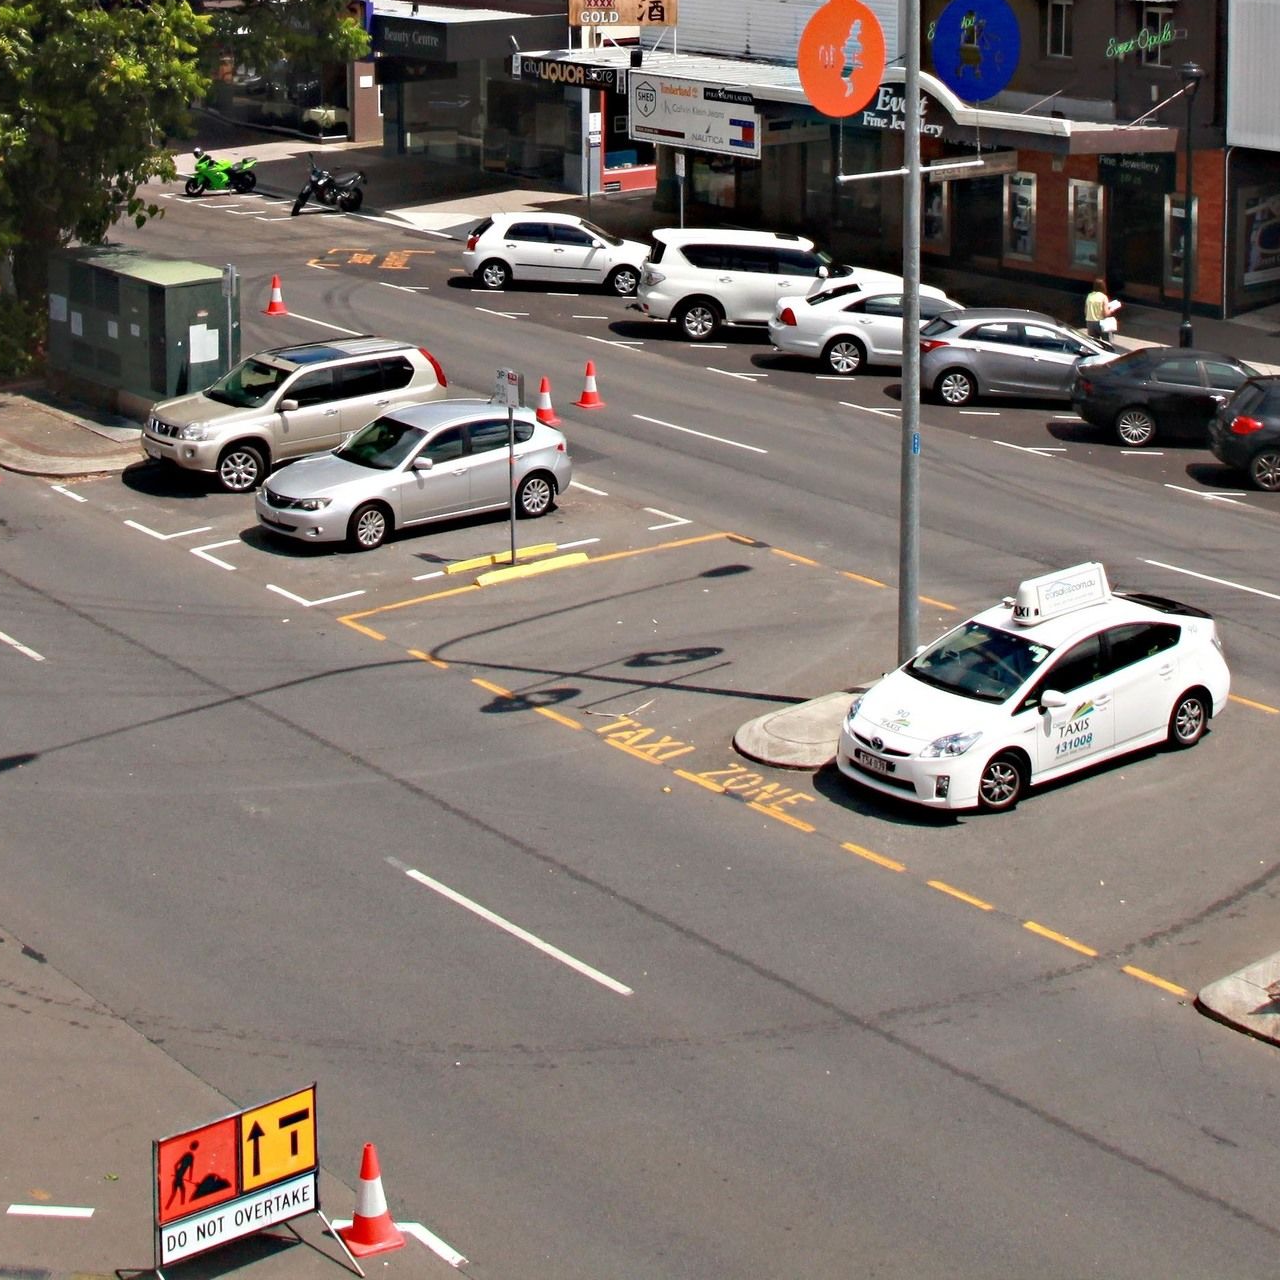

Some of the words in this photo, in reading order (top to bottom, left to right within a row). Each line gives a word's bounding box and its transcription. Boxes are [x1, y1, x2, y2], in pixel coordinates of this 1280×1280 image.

[586, 0, 612, 7] XXXX
[580, 11, 619, 23] GOLD
[384, 27, 411, 47] Beauty
[412, 30, 439, 47] Centre
[523, 60, 540, 77] city
[540, 62, 584, 84] LIQUOR
[638, 91, 654, 102] SHED
[876, 87, 928, 114] Evt
[643, 105, 648, 113] 6
[862, 111, 887, 127] Fine
[890, 115, 944, 137] Jelery
[691, 133, 724, 144] NAUTICA
[1014, 606, 1029, 617] AXI
[1059, 718, 1090, 738] TAXIS
[1055, 733, 1093, 755] 131008
[596, 715, 696, 761] TAXI
[699, 763, 816, 811] ZONE
[167, 1230, 187, 1253] DO
[196, 1216, 225, 1241] NOT
[234, 1184, 310, 1227] OVERTAKE
